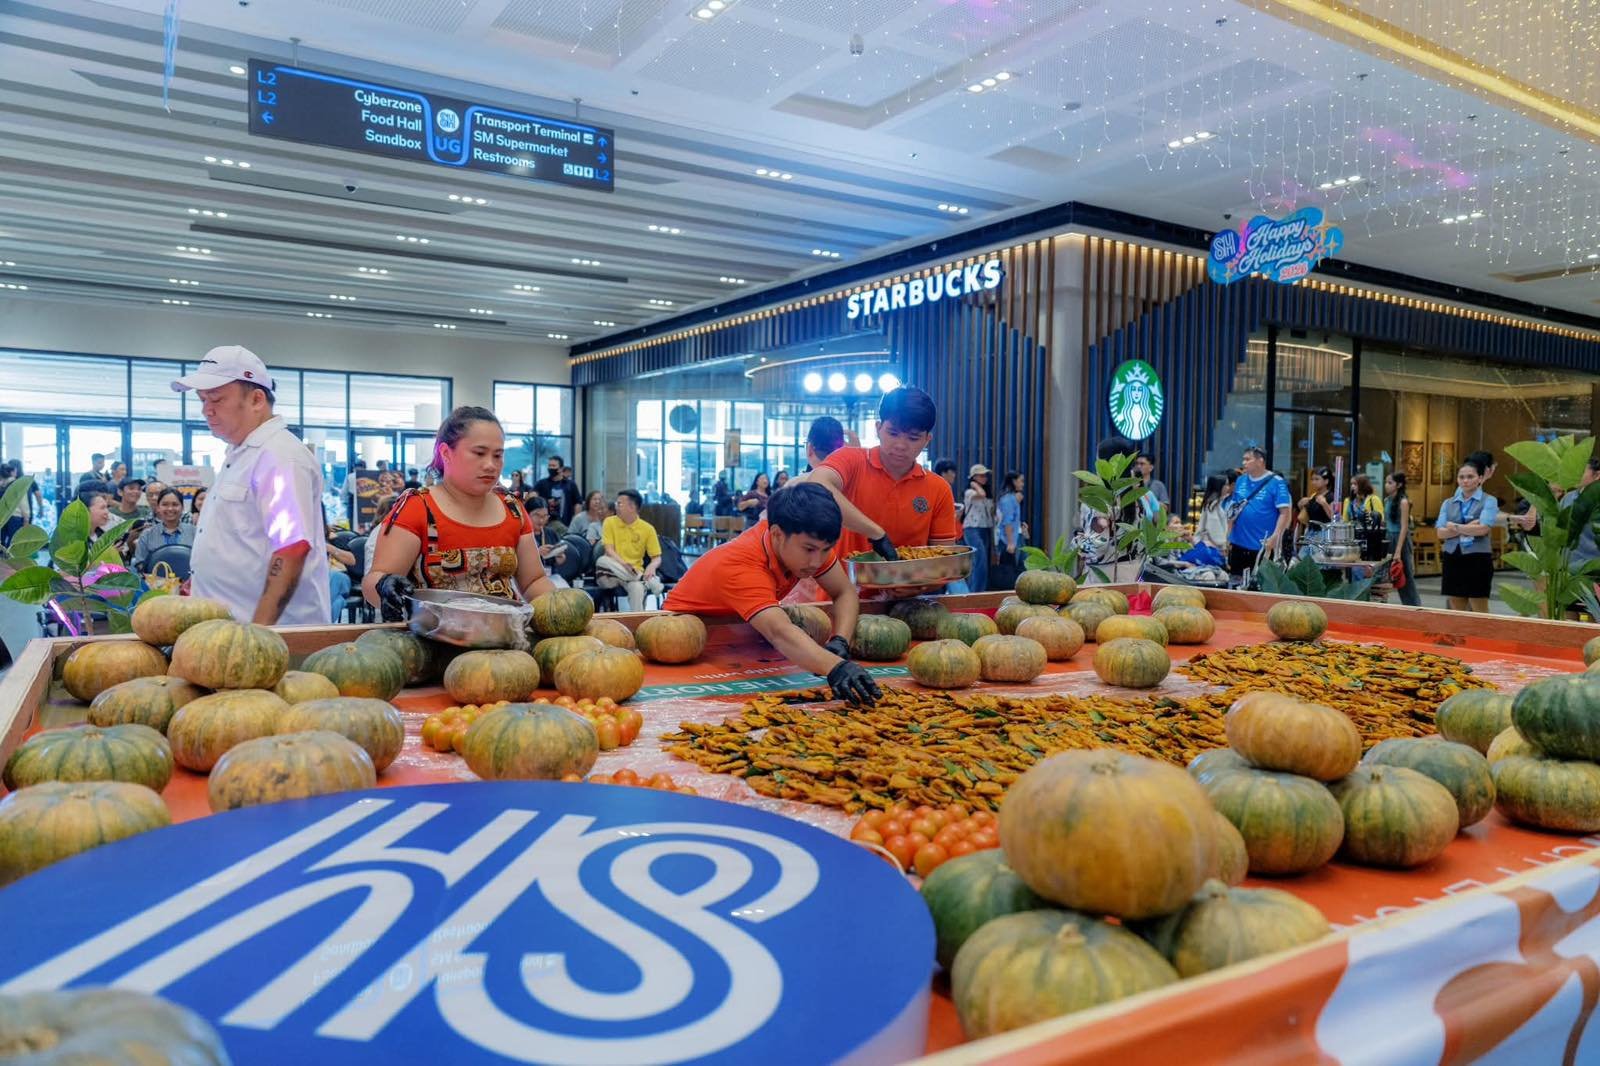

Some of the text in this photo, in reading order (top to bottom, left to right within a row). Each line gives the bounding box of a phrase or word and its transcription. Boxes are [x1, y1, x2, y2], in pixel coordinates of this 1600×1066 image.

[257, 70, 277, 86] L2
[257, 90, 277, 106] L2
[354, 89, 422, 113] Cyberzone
[361, 109, 422, 132] Food Hall
[473, 112, 581, 144] Transport Terminal
[365, 129, 422, 150] Sandbox
[434, 136, 461, 154] UG
[473, 130, 568, 158] SM Supermarket
[473, 147, 536, 169] Restrooms
[595, 168, 611, 182] L2
[1246, 219, 1306, 251] Happy
[1238, 238, 1313, 274] Holidays
[846, 259, 1001, 319] STARBUCKS
[640, 684, 733, 698] NORT
[733, 677, 801, 690] THE
